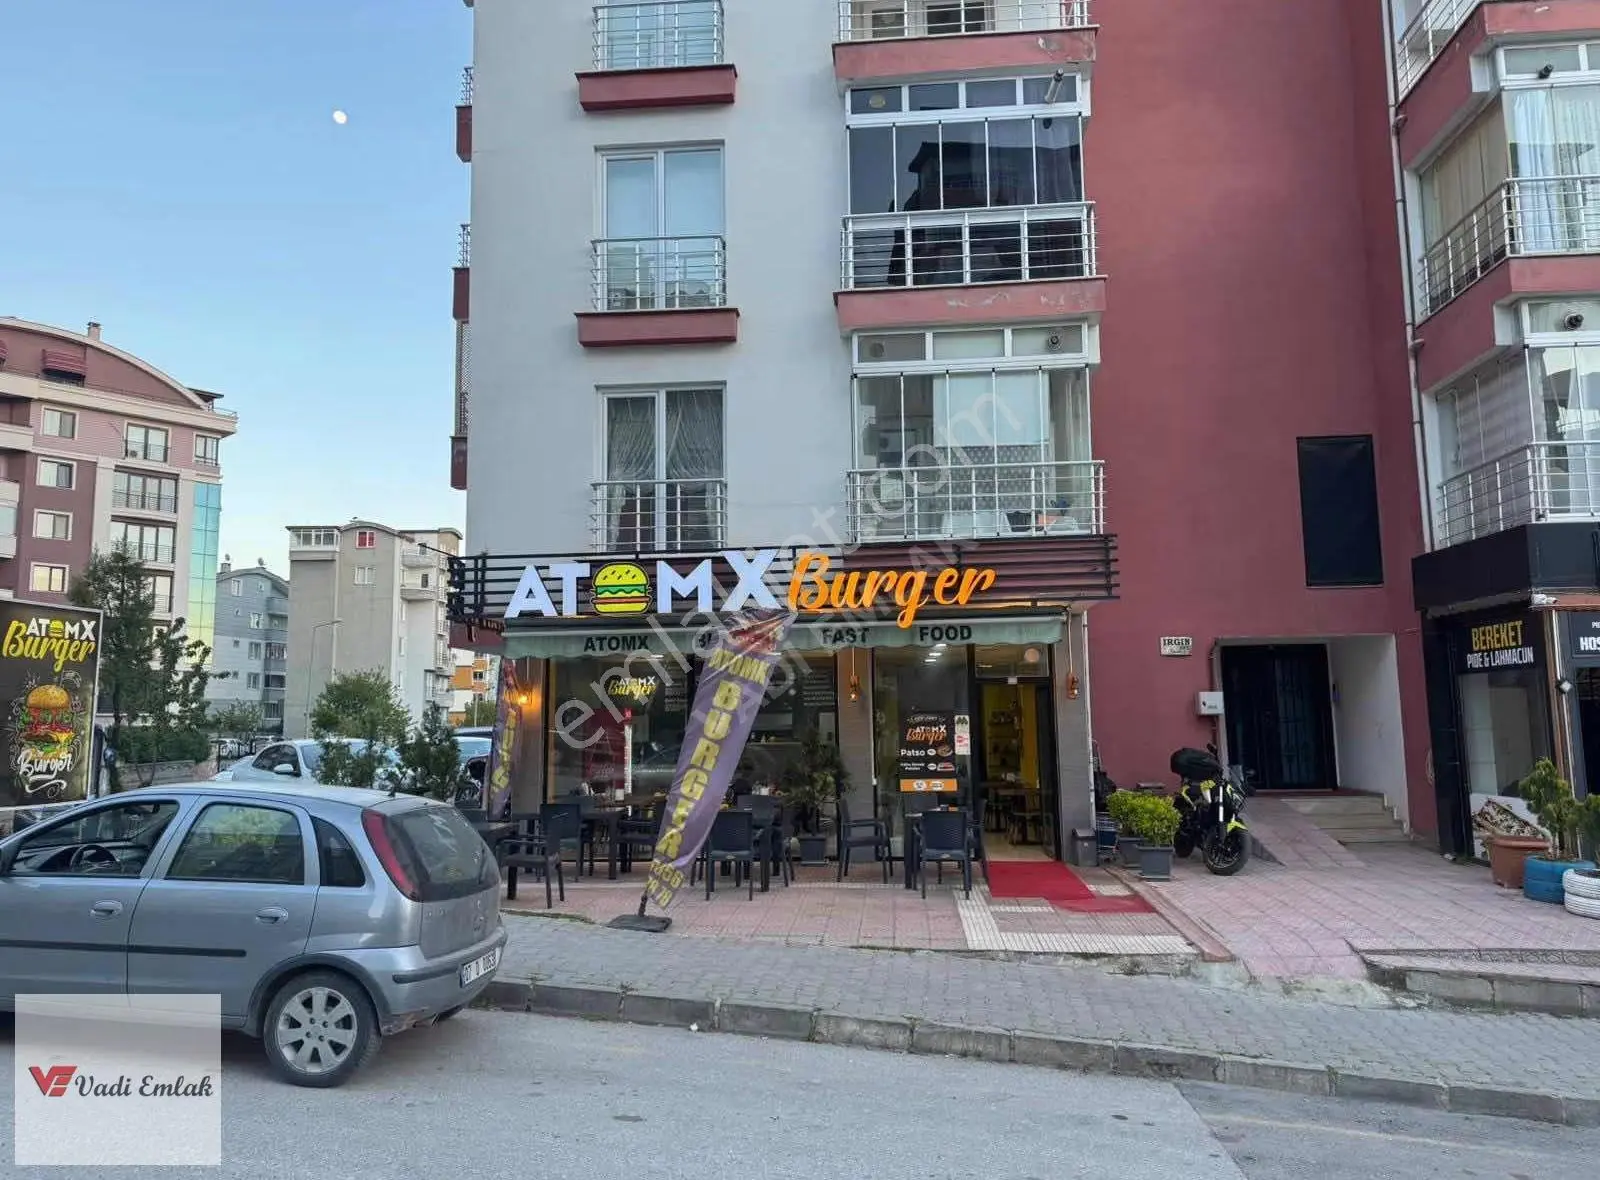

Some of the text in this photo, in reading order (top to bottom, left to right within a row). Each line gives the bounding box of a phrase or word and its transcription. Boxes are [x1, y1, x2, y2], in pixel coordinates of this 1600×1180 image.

[787, 552, 996, 628] Burger
[584, 634, 649, 651] ATOMX
[822, 625, 972, 643] FAST FOOD
[1472, 621, 1523, 650] BEREKET
[2, 620, 96, 672] Burger
[1491, 647, 1533, 666] LAHMACUN
[900, 748, 926, 756] Patso
